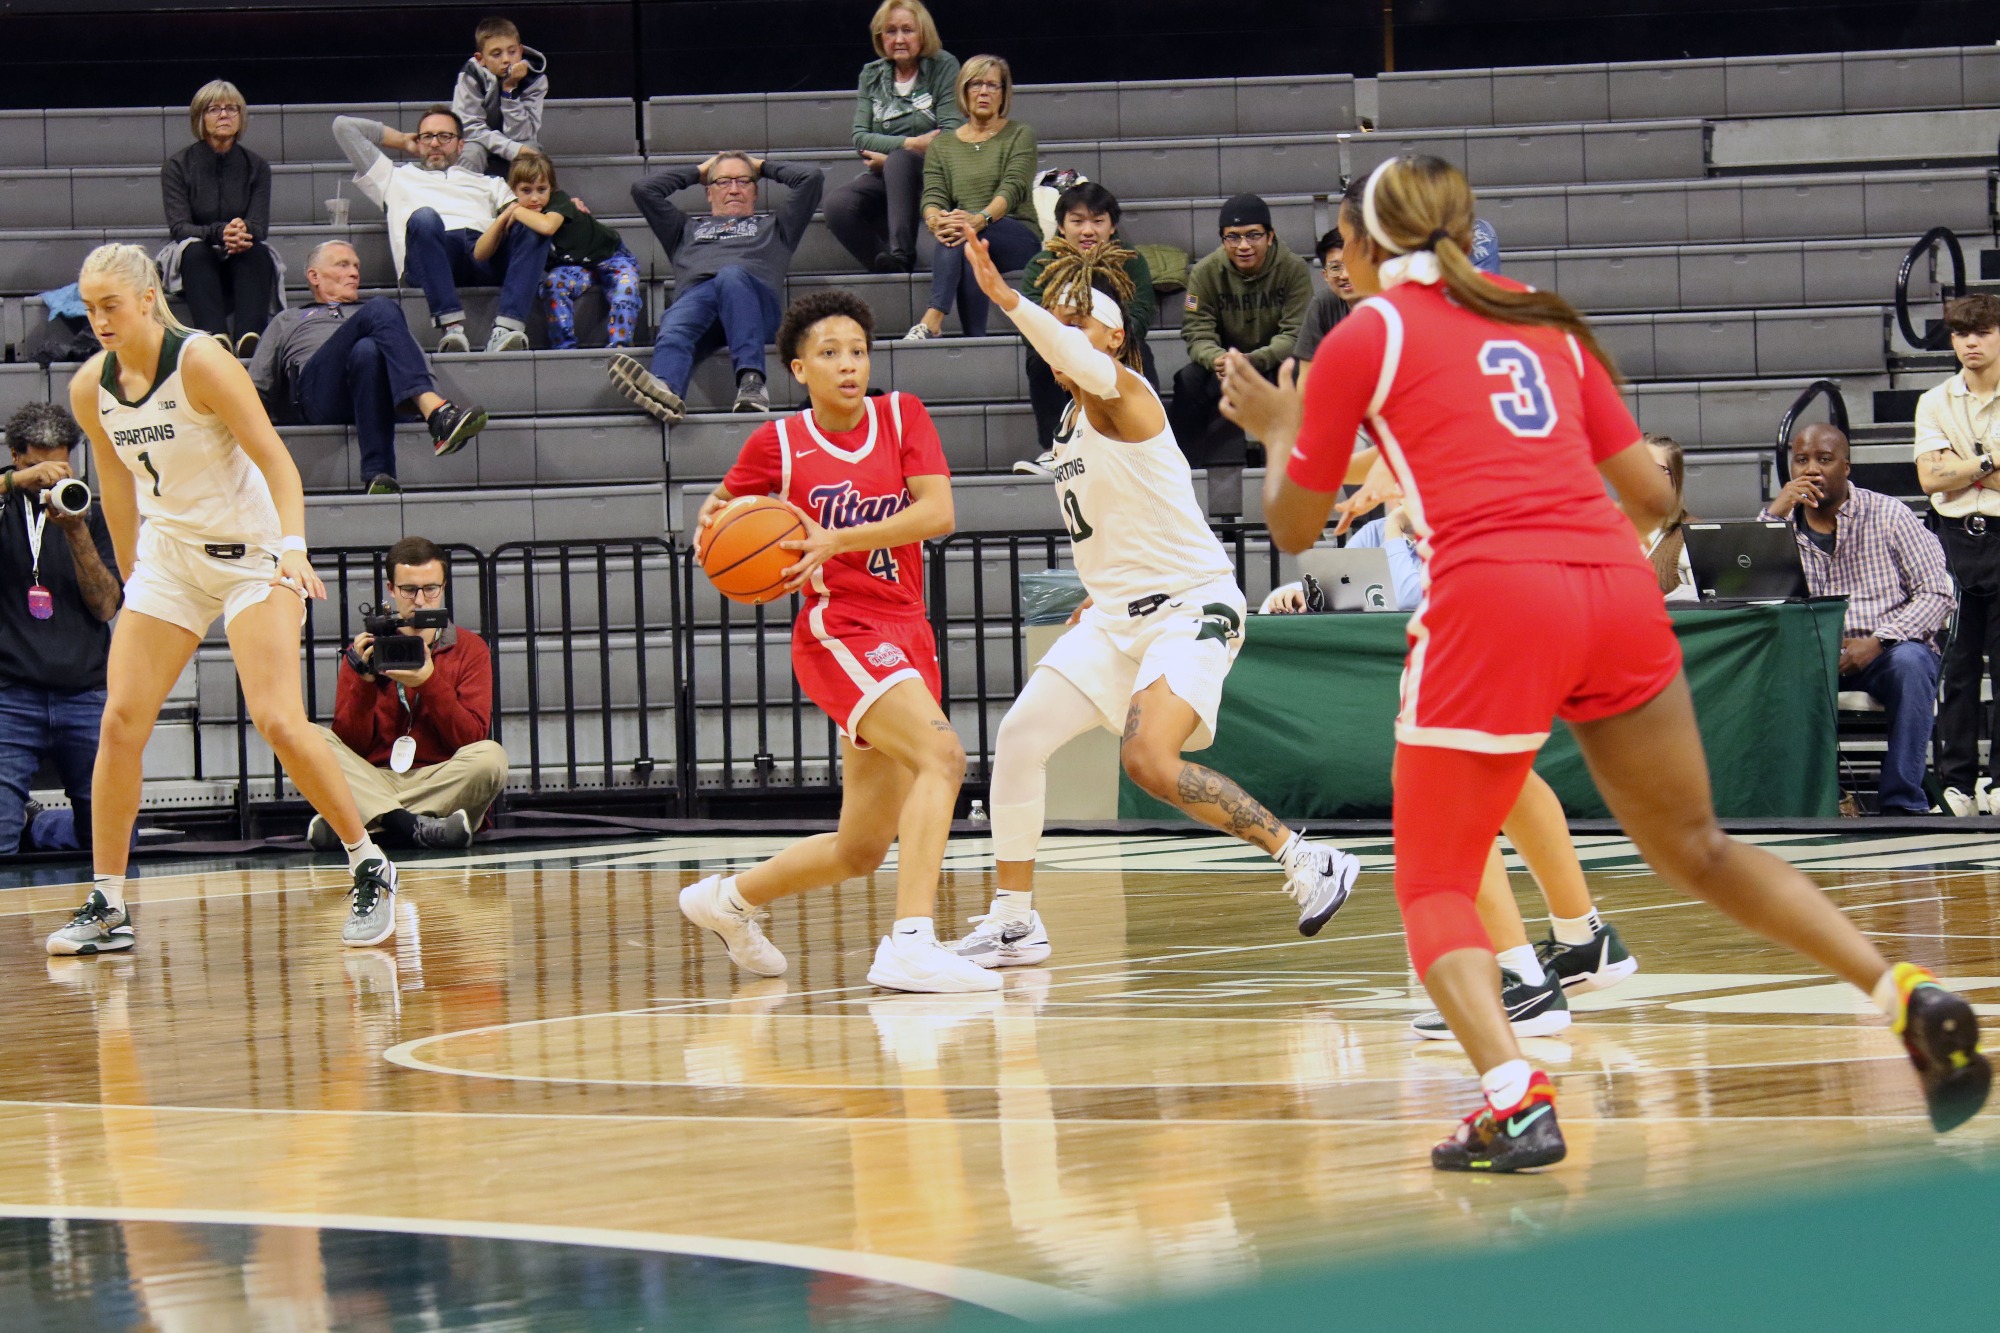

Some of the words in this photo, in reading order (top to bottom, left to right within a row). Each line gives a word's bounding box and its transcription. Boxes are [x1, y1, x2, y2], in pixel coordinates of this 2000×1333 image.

[1217, 288, 1286, 311] SPARTANS
[1476, 339, 1559, 438] 3
[113, 424, 176, 447] SPARTANS
[138, 451, 162, 497] 1
[1063, 488, 1094, 544] 0
[866, 547, 900, 584] 4
